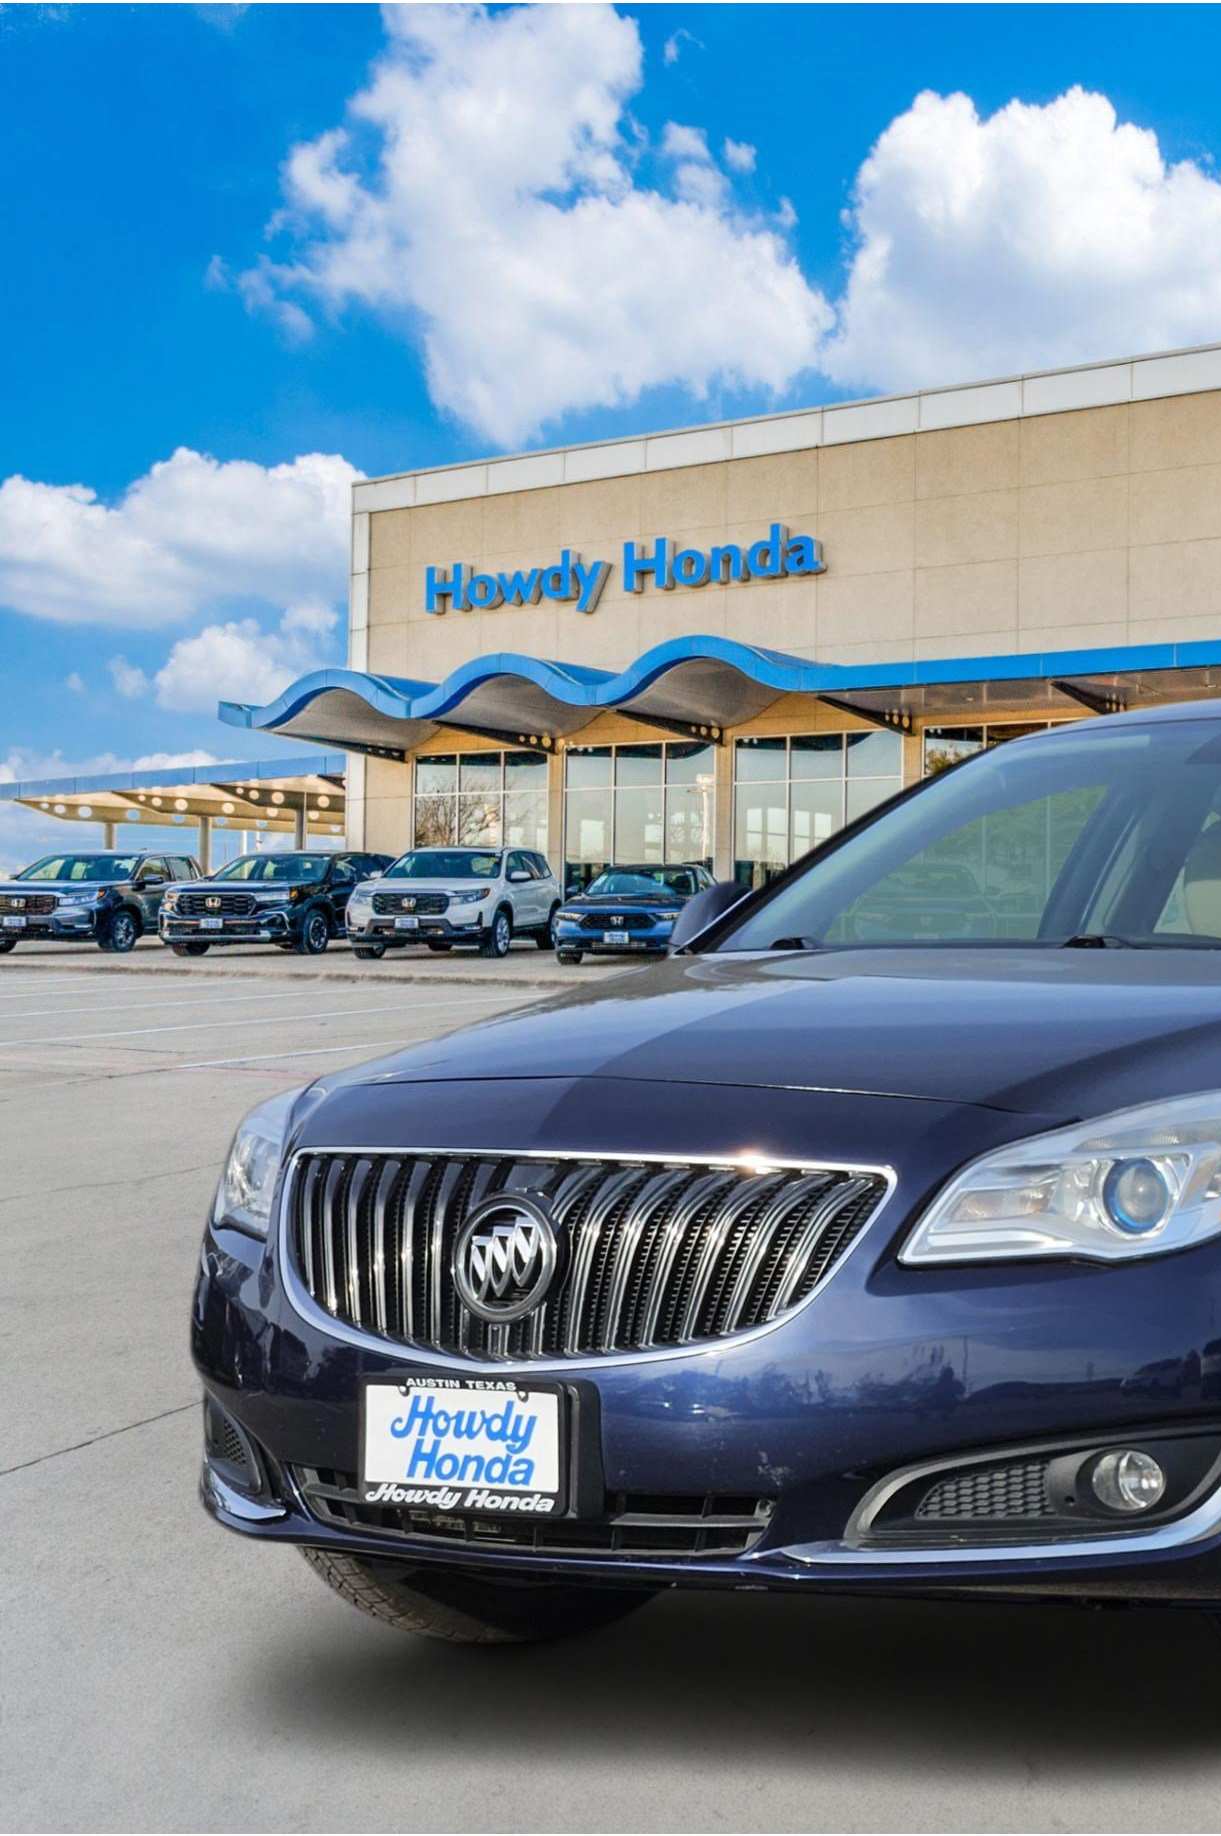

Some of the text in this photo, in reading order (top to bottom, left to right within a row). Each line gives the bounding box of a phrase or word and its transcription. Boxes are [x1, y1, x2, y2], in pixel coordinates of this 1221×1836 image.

[425, 523, 827, 614] Howdy Honda
[405, 1377, 517, 1392] AUSTIN TEXAS
[390, 1394, 538, 1454] Howdy
[406, 1438, 535, 1487] Honda
[365, 1482, 555, 1513] Howdy Honda
